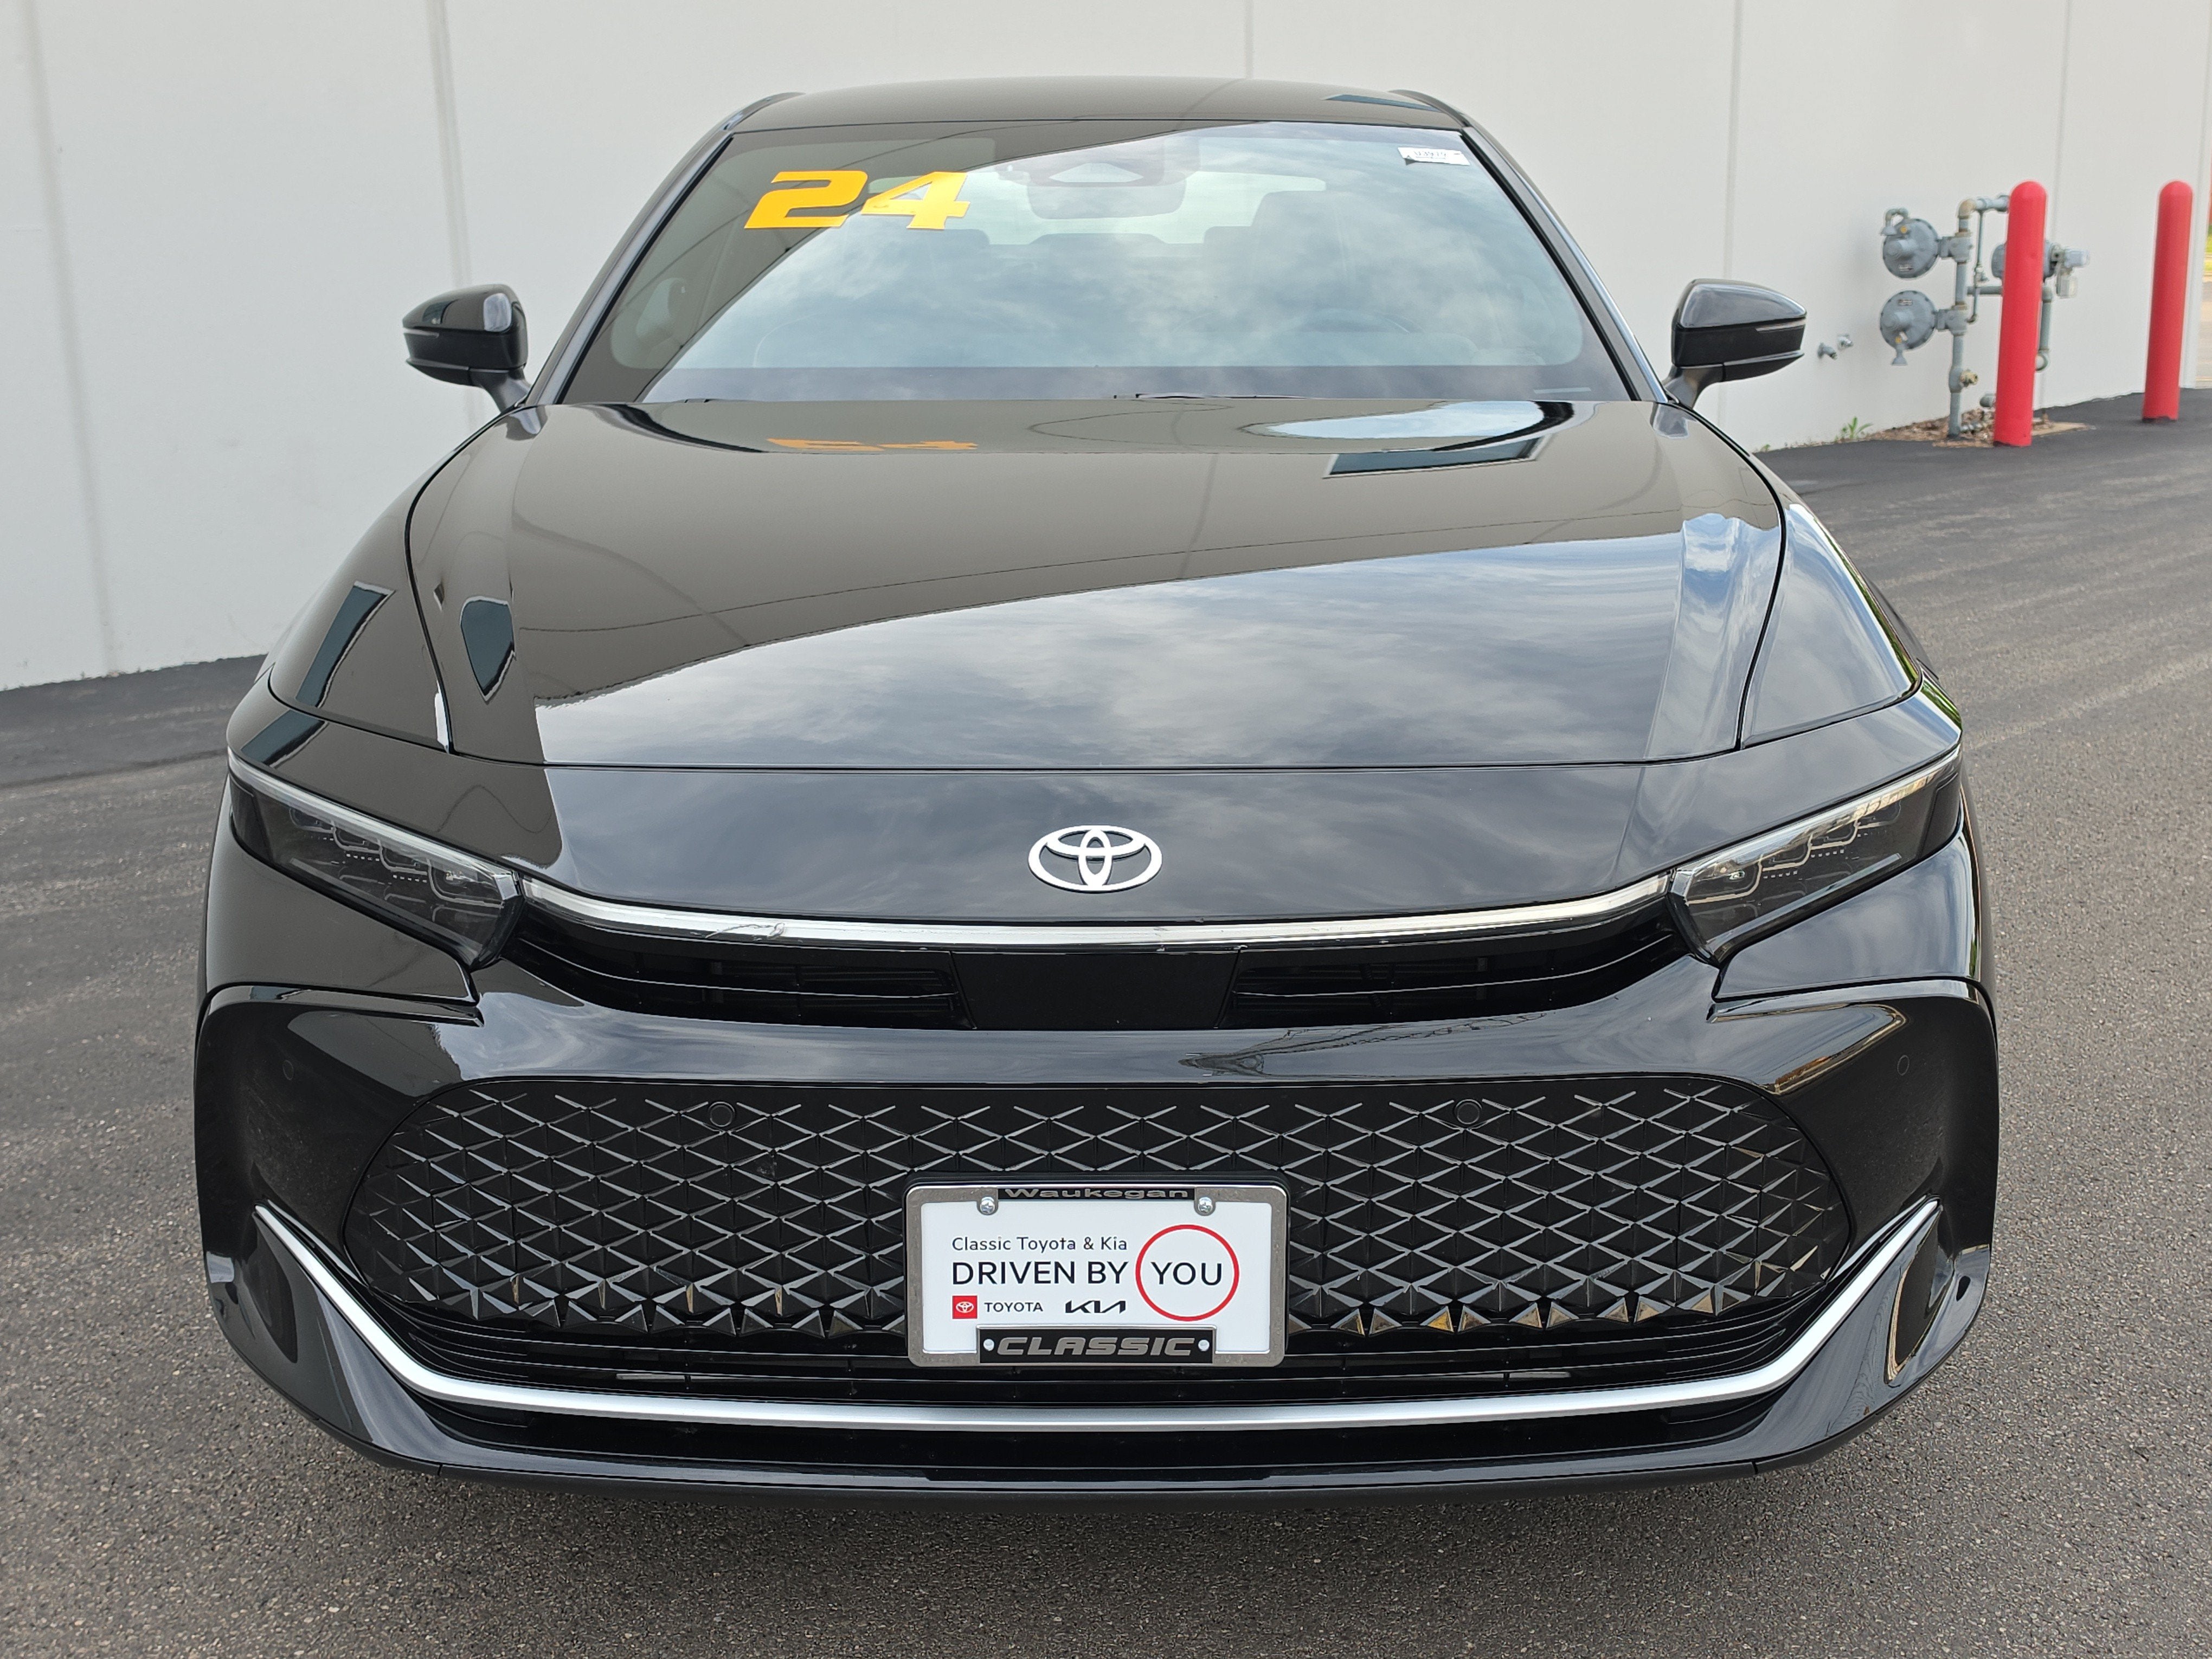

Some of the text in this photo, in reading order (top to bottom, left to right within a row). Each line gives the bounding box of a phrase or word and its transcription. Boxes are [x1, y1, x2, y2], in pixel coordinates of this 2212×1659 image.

[744, 169, 970, 230] 24
[1004, 1188, 1188, 1199] Waukegan
[952, 1236, 1128, 1253] Classic Toyota & Kia
[953, 1261, 1222, 1286] DRIVEN BY YOU
[984, 1300, 1126, 1314] TOYOTA KIA
[996, 1336, 1195, 1356] CLASSIC
